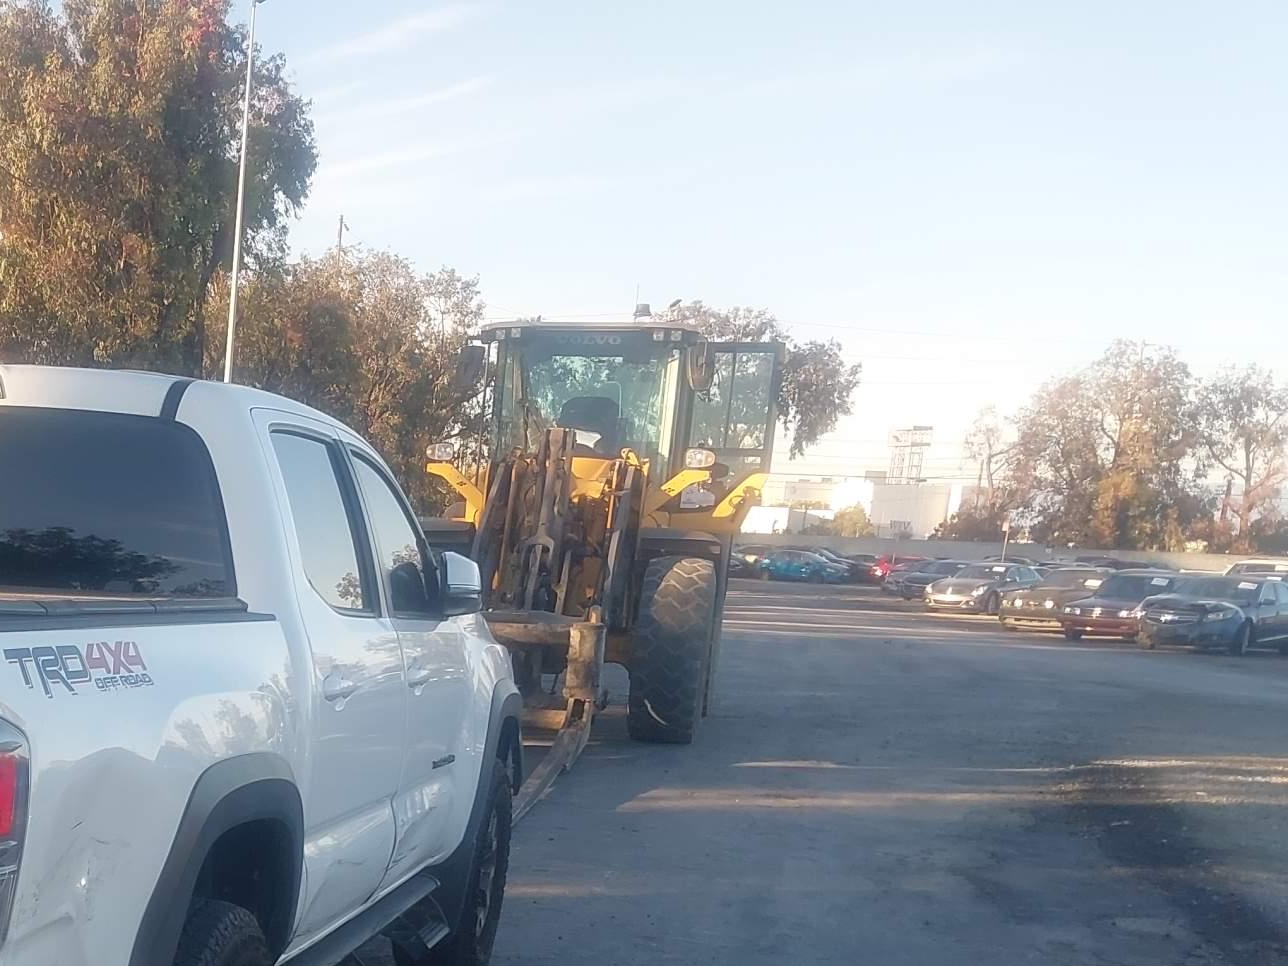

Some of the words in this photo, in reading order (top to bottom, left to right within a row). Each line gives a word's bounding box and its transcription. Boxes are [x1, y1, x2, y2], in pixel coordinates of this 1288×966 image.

[556, 335, 622, 345] VOLVO
[3, 644, 92, 699] TRD
[94, 675, 121, 692] OFF
[119, 672, 154, 687] ROAD
